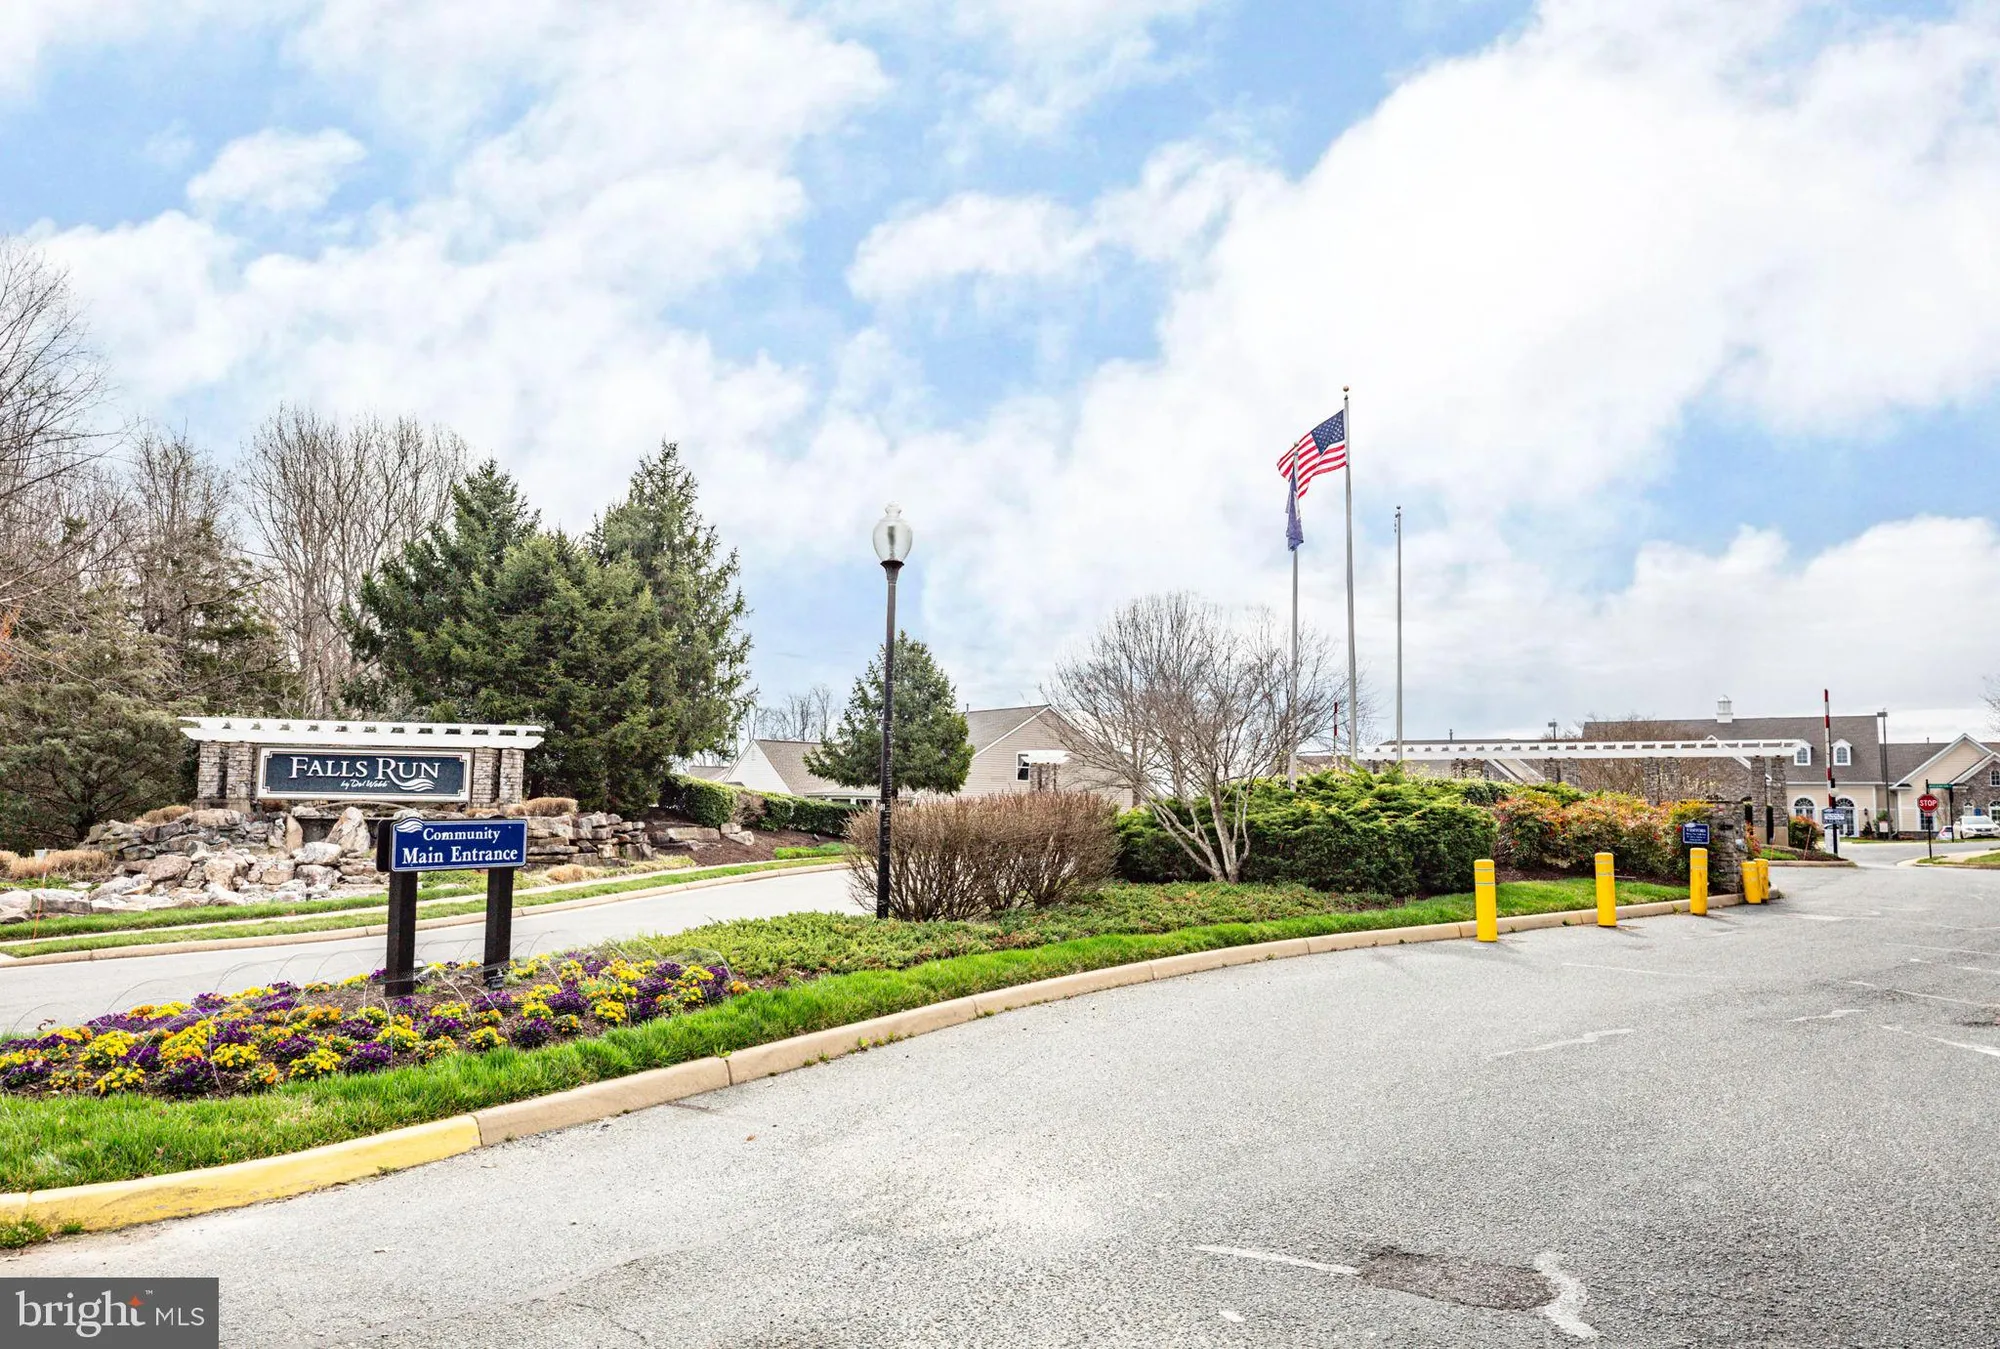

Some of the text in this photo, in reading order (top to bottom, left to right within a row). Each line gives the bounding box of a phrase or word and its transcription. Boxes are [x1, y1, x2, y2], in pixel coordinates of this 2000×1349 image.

[288, 756, 441, 780] FALLS RUN
[340, 780, 350, 790] by
[1919, 799, 1938, 807] STOP
[423, 826, 501, 844] Community
[402, 846, 518, 865] Main Entrance
